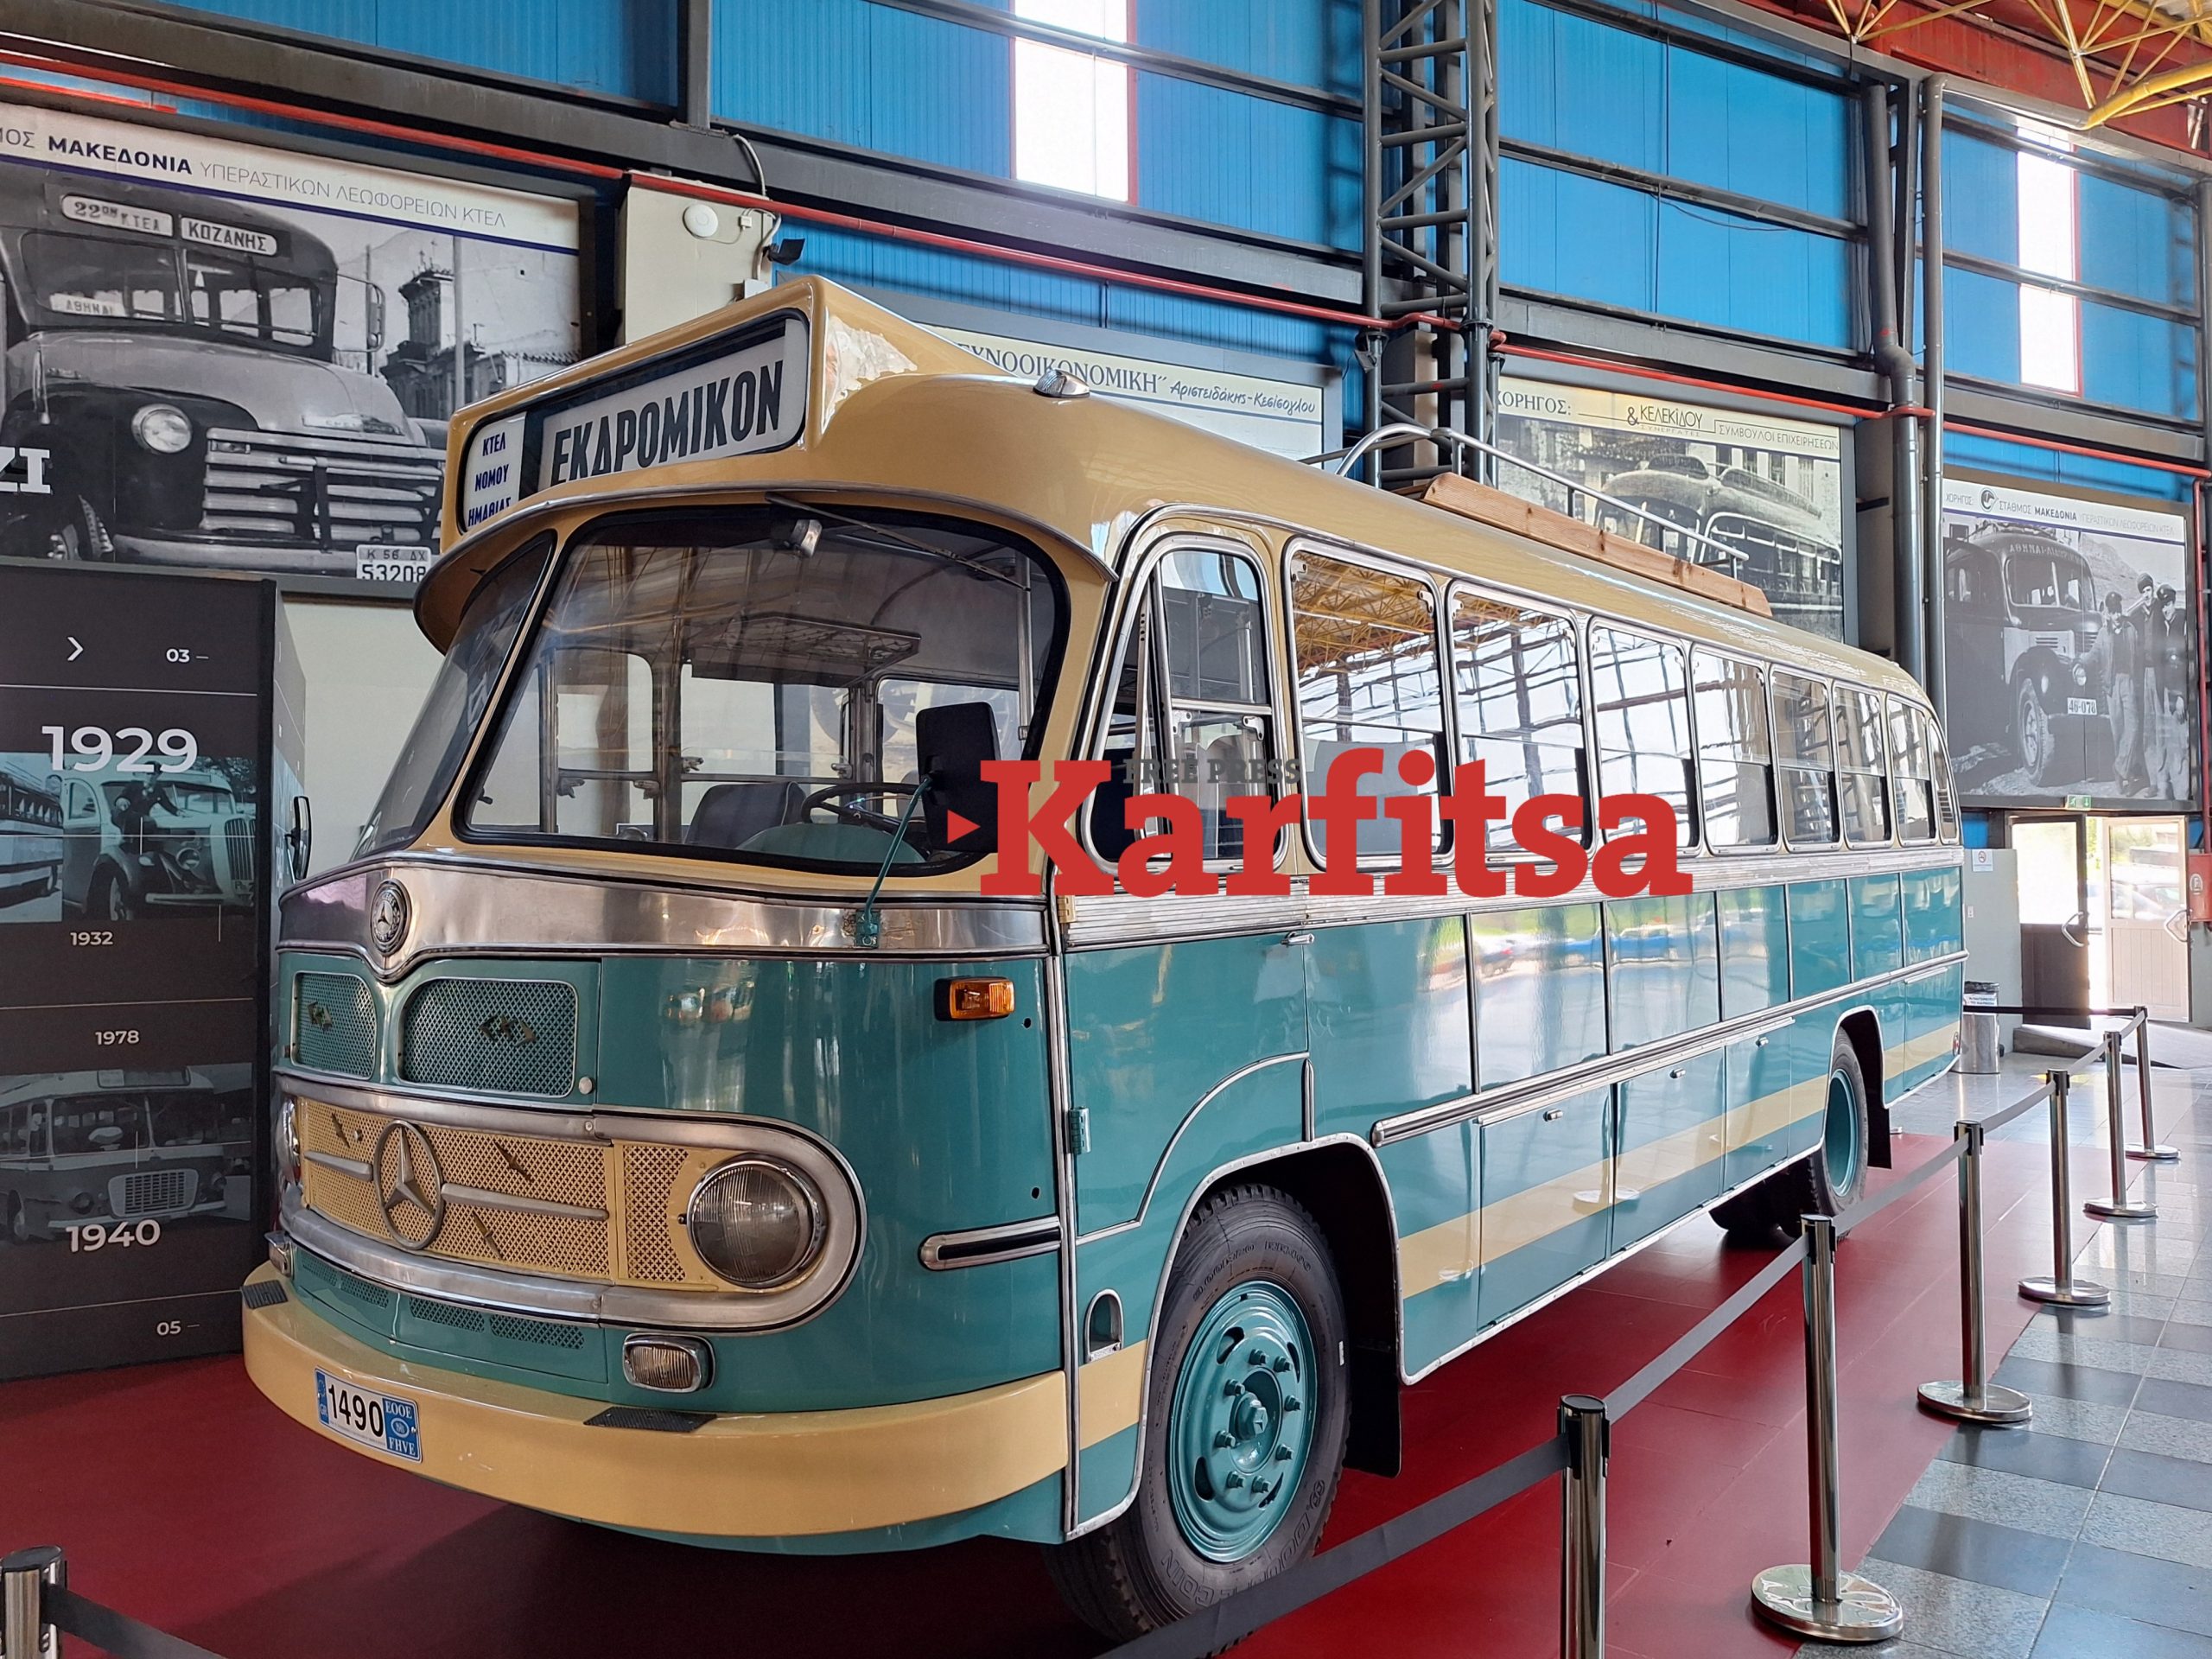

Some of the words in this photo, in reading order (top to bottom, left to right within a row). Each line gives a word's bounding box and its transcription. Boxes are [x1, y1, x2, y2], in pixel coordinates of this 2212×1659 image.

[0, 128, 35, 149] ΟΣ
[48, 135, 193, 175] ΜΑΚΕΔΟΝΙΑ
[200, 162, 330, 198] ΥΠΕΡΑΣΤΙΚΩΝ
[336, 186, 457, 219] ΛΕΩΦΟΡΕΙΩΝ
[462, 207, 506, 228] ΚΤΕΛ
[188, 220, 268, 252] ΚΟΖΑΝΗΣ
[550, 360, 784, 486] ΕΚΔΡΟΜΙΚΟΝ
[482, 431, 506, 457] ΚΤΕΛ
[1719, 424, 1775, 442] ΣΥΜΒΟΥΛΟΙ
[1777, 433, 1839, 450] ΕΠΙΧΕΙΡΗΣΕΩΝ
[474, 463, 510, 493] ΝΟΜΟΥ
[1999, 500, 2032, 515] ΣΤΑΘΜΟΣ
[2034, 505, 2077, 521] ΜΑΚΕΔΟΝΙΑ
[361, 563, 427, 583] 53208
[166, 648, 191, 663] 03
[41, 726, 199, 773] 1929
[70, 931, 114, 946] 1932
[95, 1029, 140, 1046] 1978
[66, 1217, 162, 1253] 1940
[156, 1320, 182, 1336] 05
[328, 1383, 384, 1437] 1490
[388, 1436, 416, 1457] FHVE
